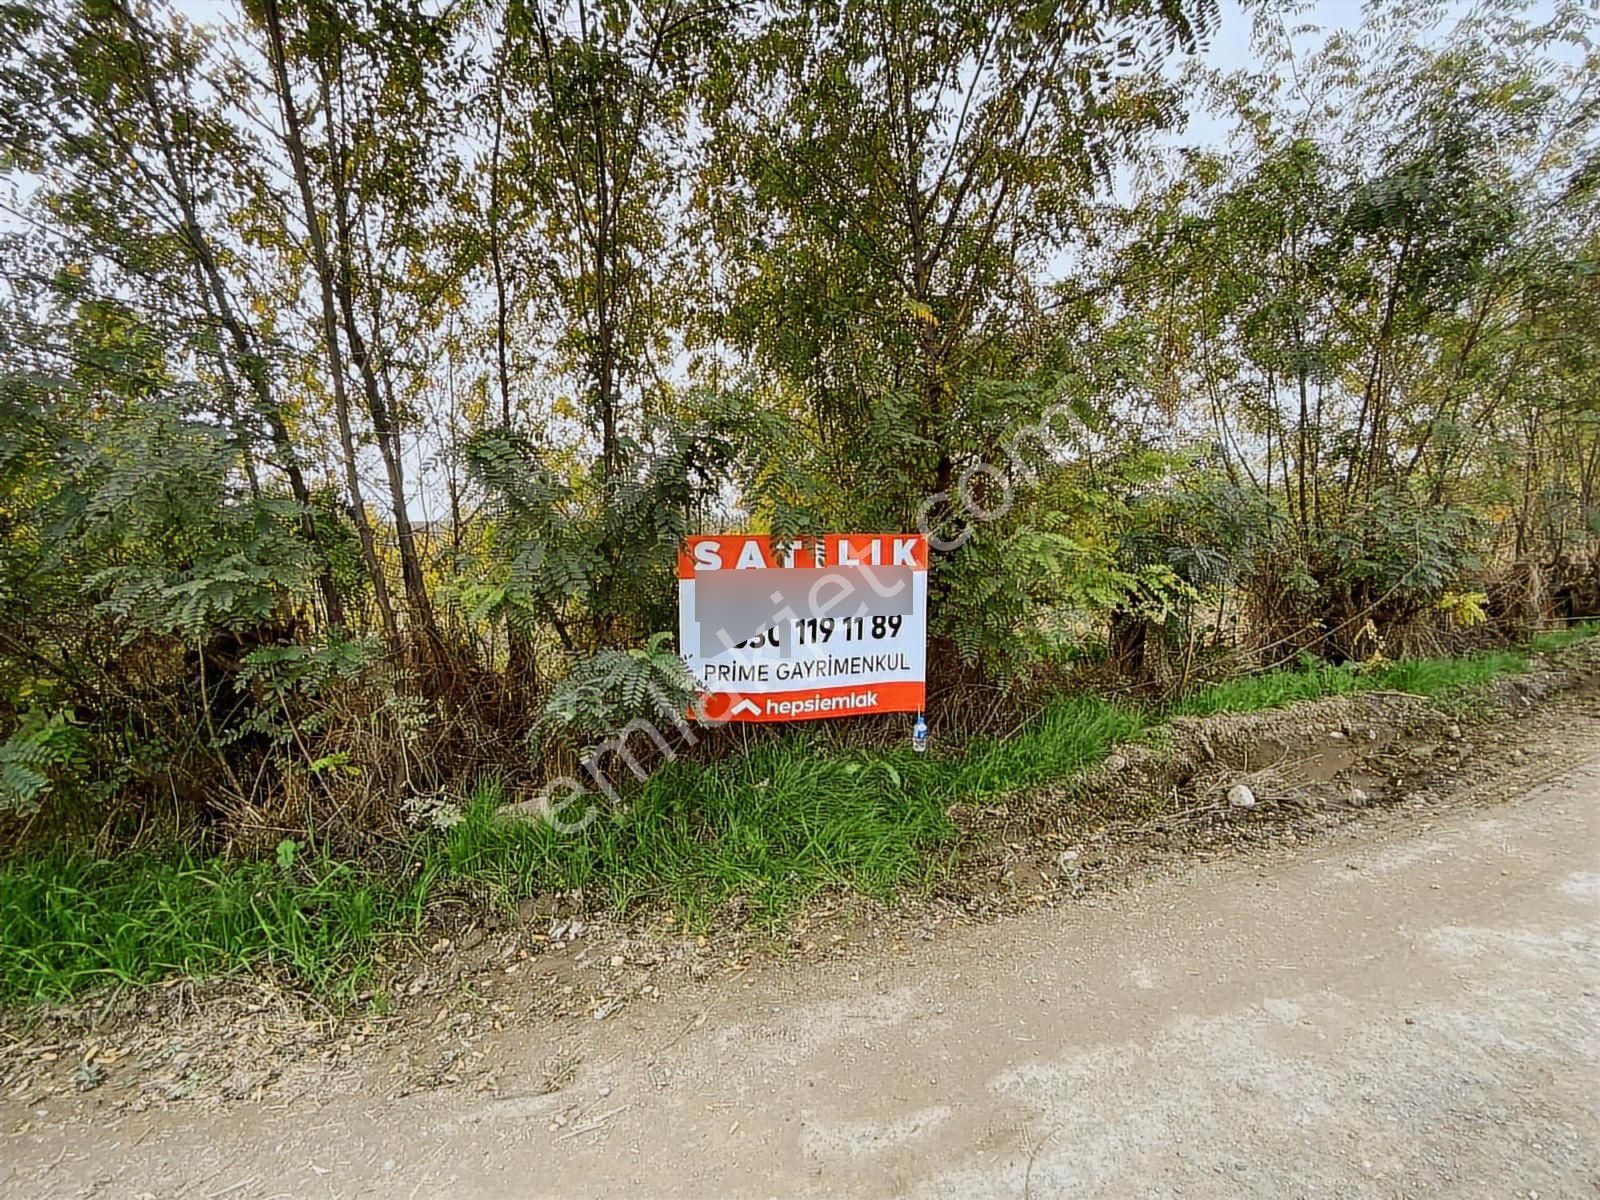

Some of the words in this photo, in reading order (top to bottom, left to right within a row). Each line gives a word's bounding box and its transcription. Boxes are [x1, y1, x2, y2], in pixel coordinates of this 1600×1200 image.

[796, 617, 835, 645] 119
[872, 614, 902, 639] 89
[704, 661, 769, 682] PRİME
[776, 652, 910, 680] GAYRİMENKUL
[766, 690, 878, 717] hepsiemlak
